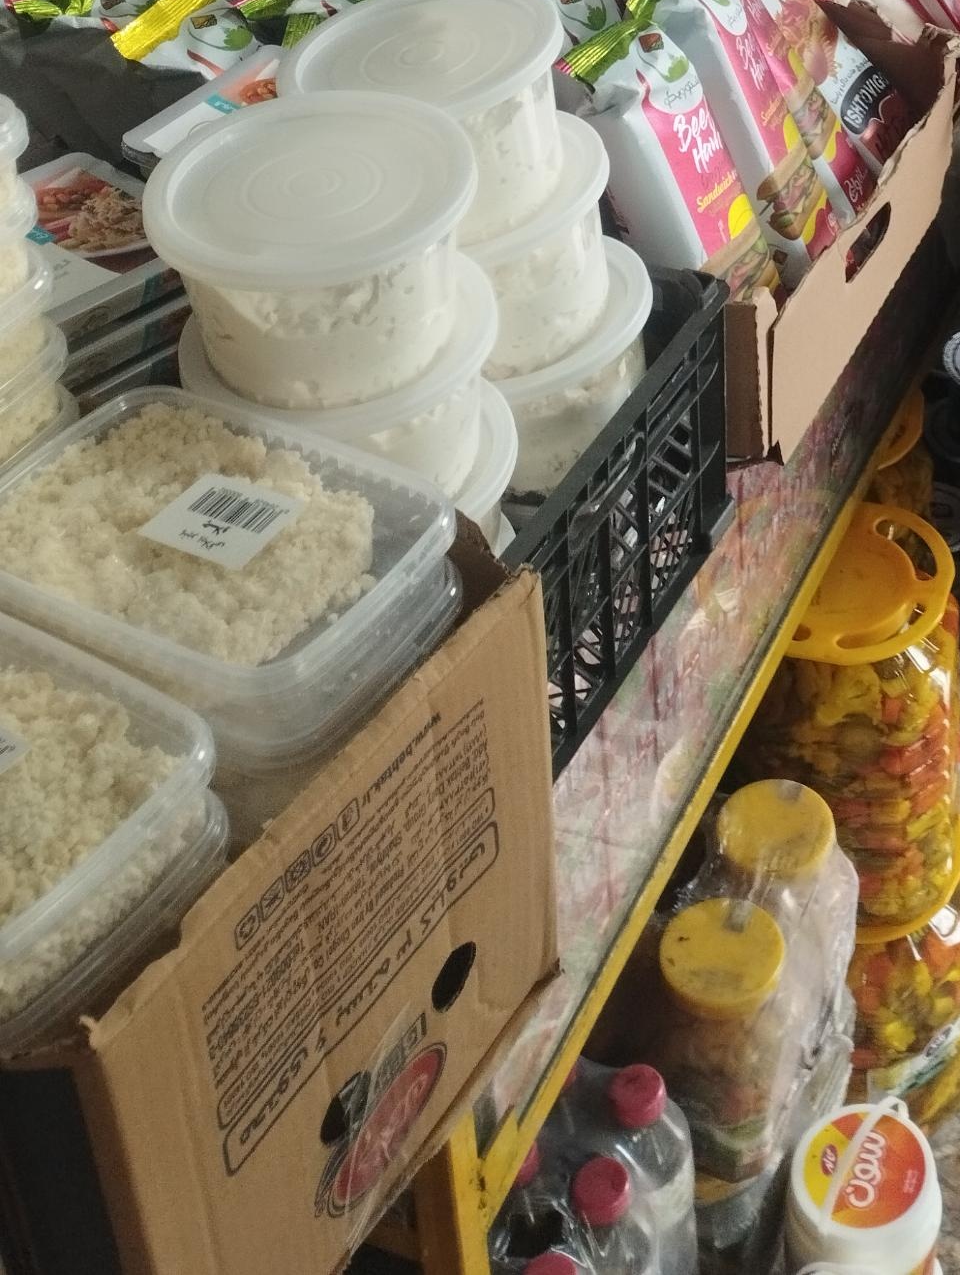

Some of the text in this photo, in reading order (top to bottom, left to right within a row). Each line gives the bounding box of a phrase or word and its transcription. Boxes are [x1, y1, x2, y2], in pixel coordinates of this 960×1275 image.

[237, 1042, 309, 1150] محتوی
[336, 956, 391, 1027] بسته
[419, 836, 486, 935] کیلویی
[844, 1129, 887, 1209] سون
